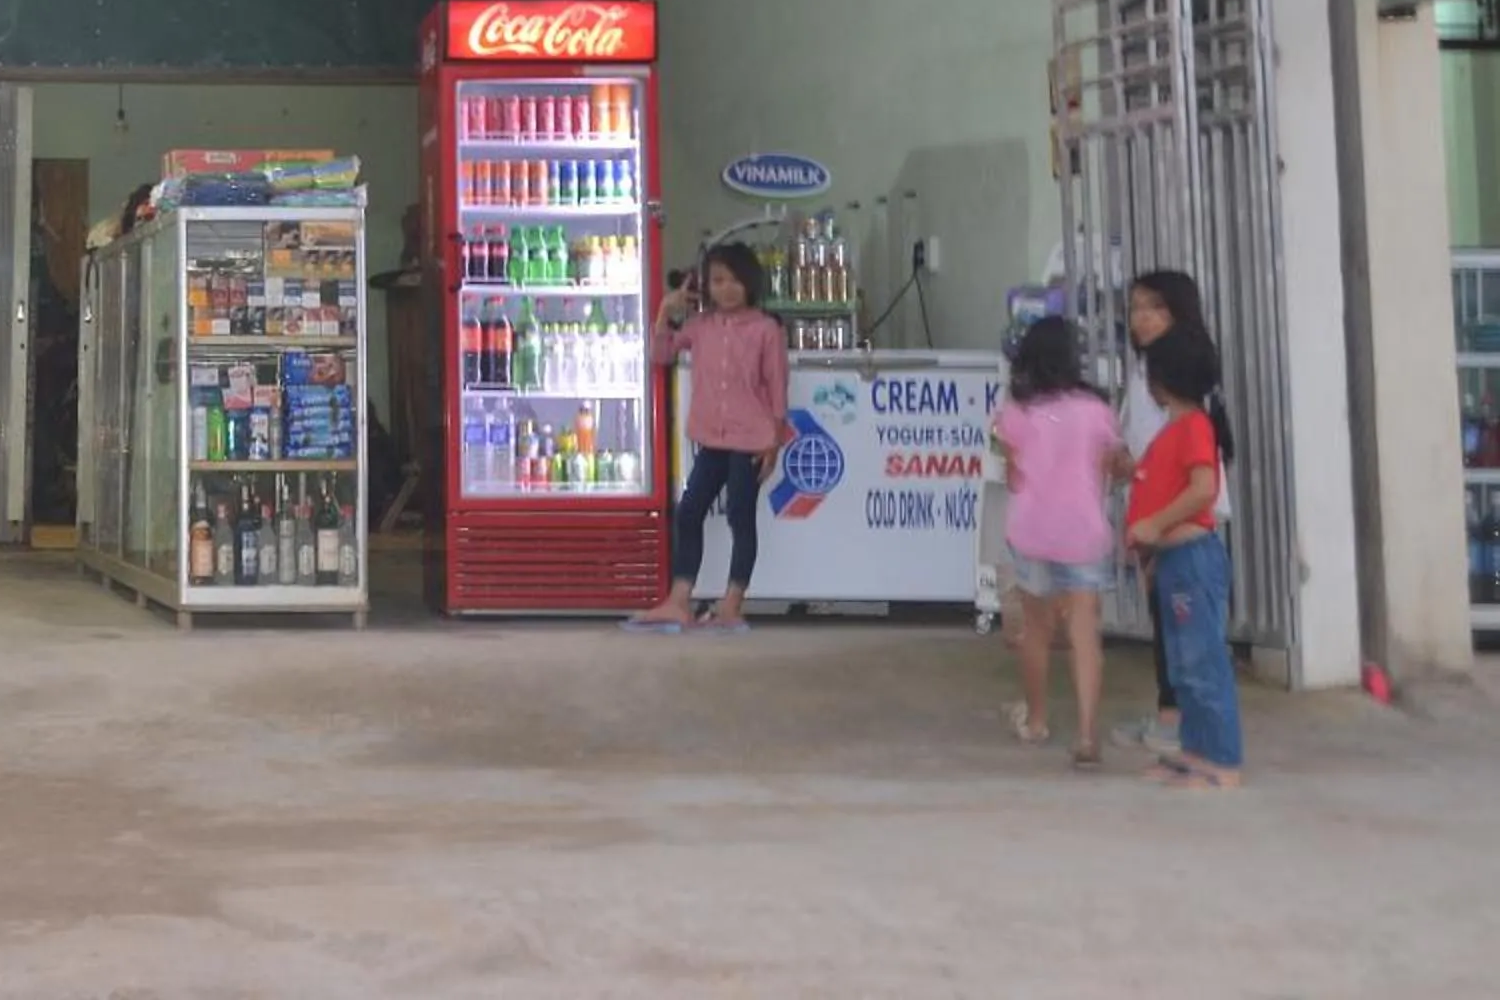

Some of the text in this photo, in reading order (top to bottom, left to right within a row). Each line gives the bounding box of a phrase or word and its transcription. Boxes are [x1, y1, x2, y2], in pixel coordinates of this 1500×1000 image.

[733, 162, 821, 185] VINAMILK
[871, 379, 959, 416] CREAM
[865, 488, 897, 530] COLD
[900, 488, 935, 530] DRINK
